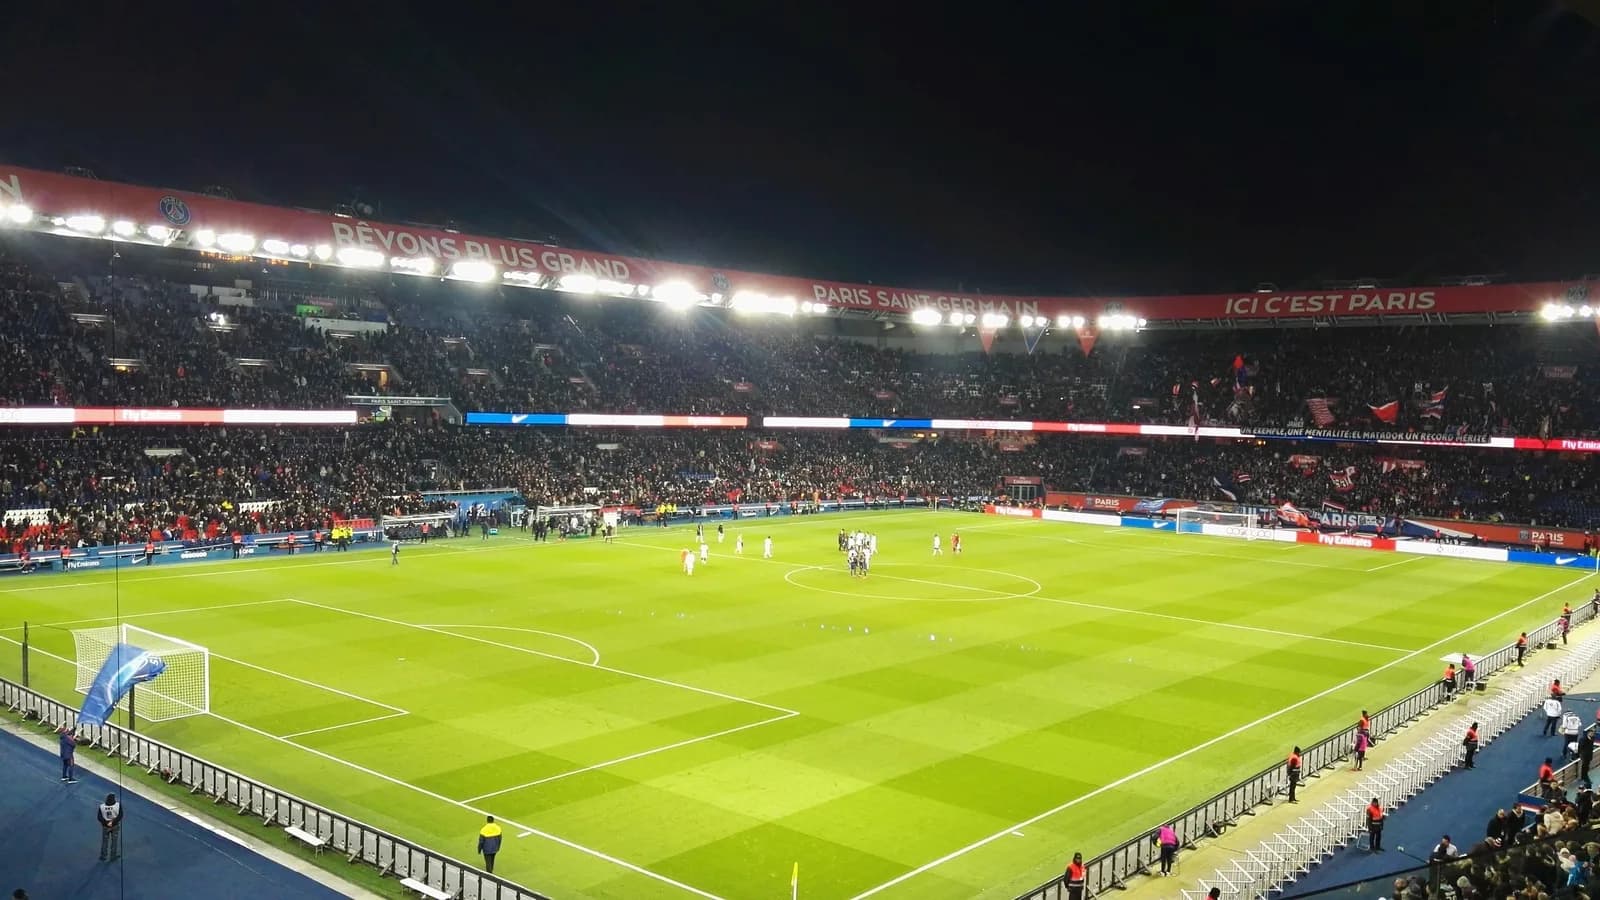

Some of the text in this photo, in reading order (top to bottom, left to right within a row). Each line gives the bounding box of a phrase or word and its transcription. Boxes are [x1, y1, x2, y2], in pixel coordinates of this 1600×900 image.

[332, 221, 630, 280] RÊVONS PLUS GRAND
[812, 284, 1039, 315] PARIS SAINT-GERMAIN
[1225, 291, 1436, 314] ICI C'EST PARIS
[1287, 428, 1304, 436] UNE
[1362, 431, 1405, 440] MATADOR
[1405, 432, 1418, 441] UN
[1420, 432, 1454, 442] RECORD
[1562, 440, 1576, 450] Fly
[1320, 512, 1357, 527] ARIS
